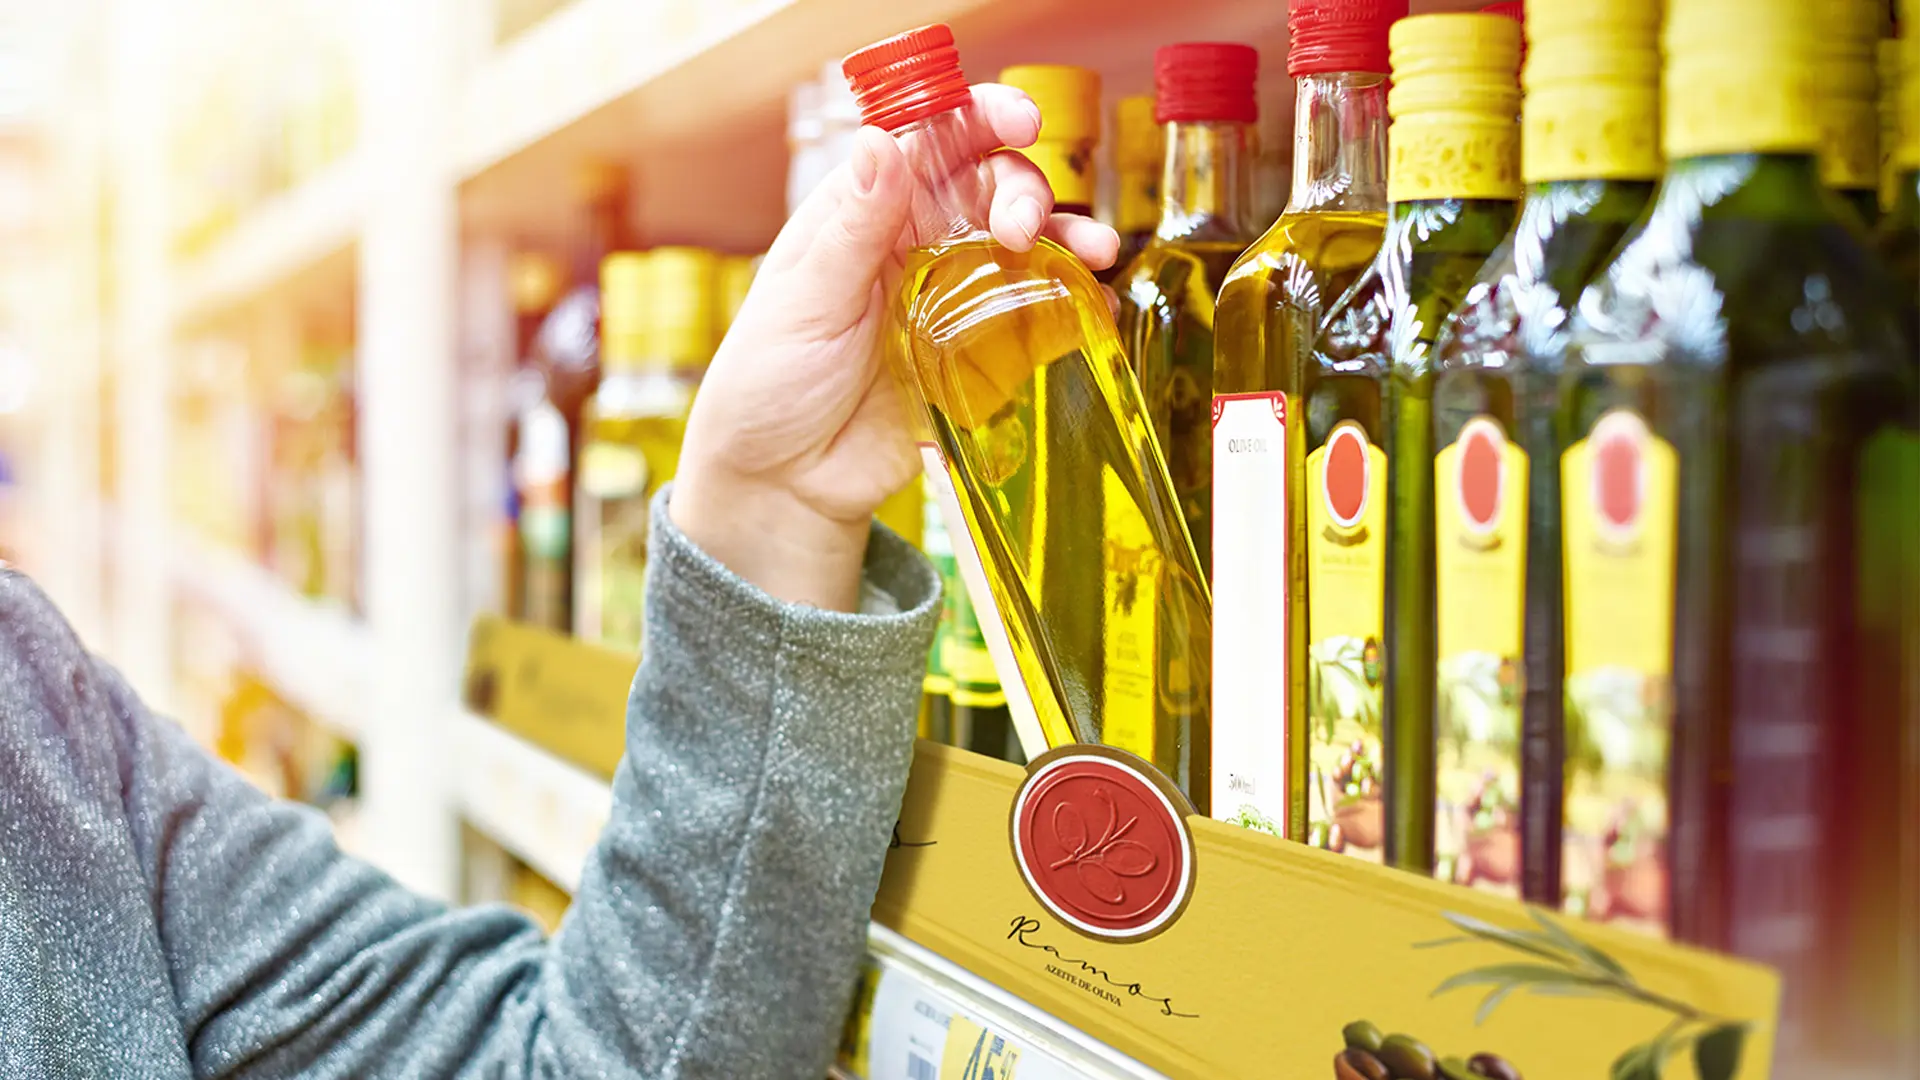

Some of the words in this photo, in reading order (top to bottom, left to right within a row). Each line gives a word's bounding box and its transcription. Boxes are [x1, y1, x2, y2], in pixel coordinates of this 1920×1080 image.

[1228, 438, 1252, 453] OLIVE
[1007, 915, 1200, 1018] Ramos
[1045, 963, 1077, 985] AZEITE
[1078, 978, 1092, 993] DE
[1092, 986, 1121, 1007] OLIVA
